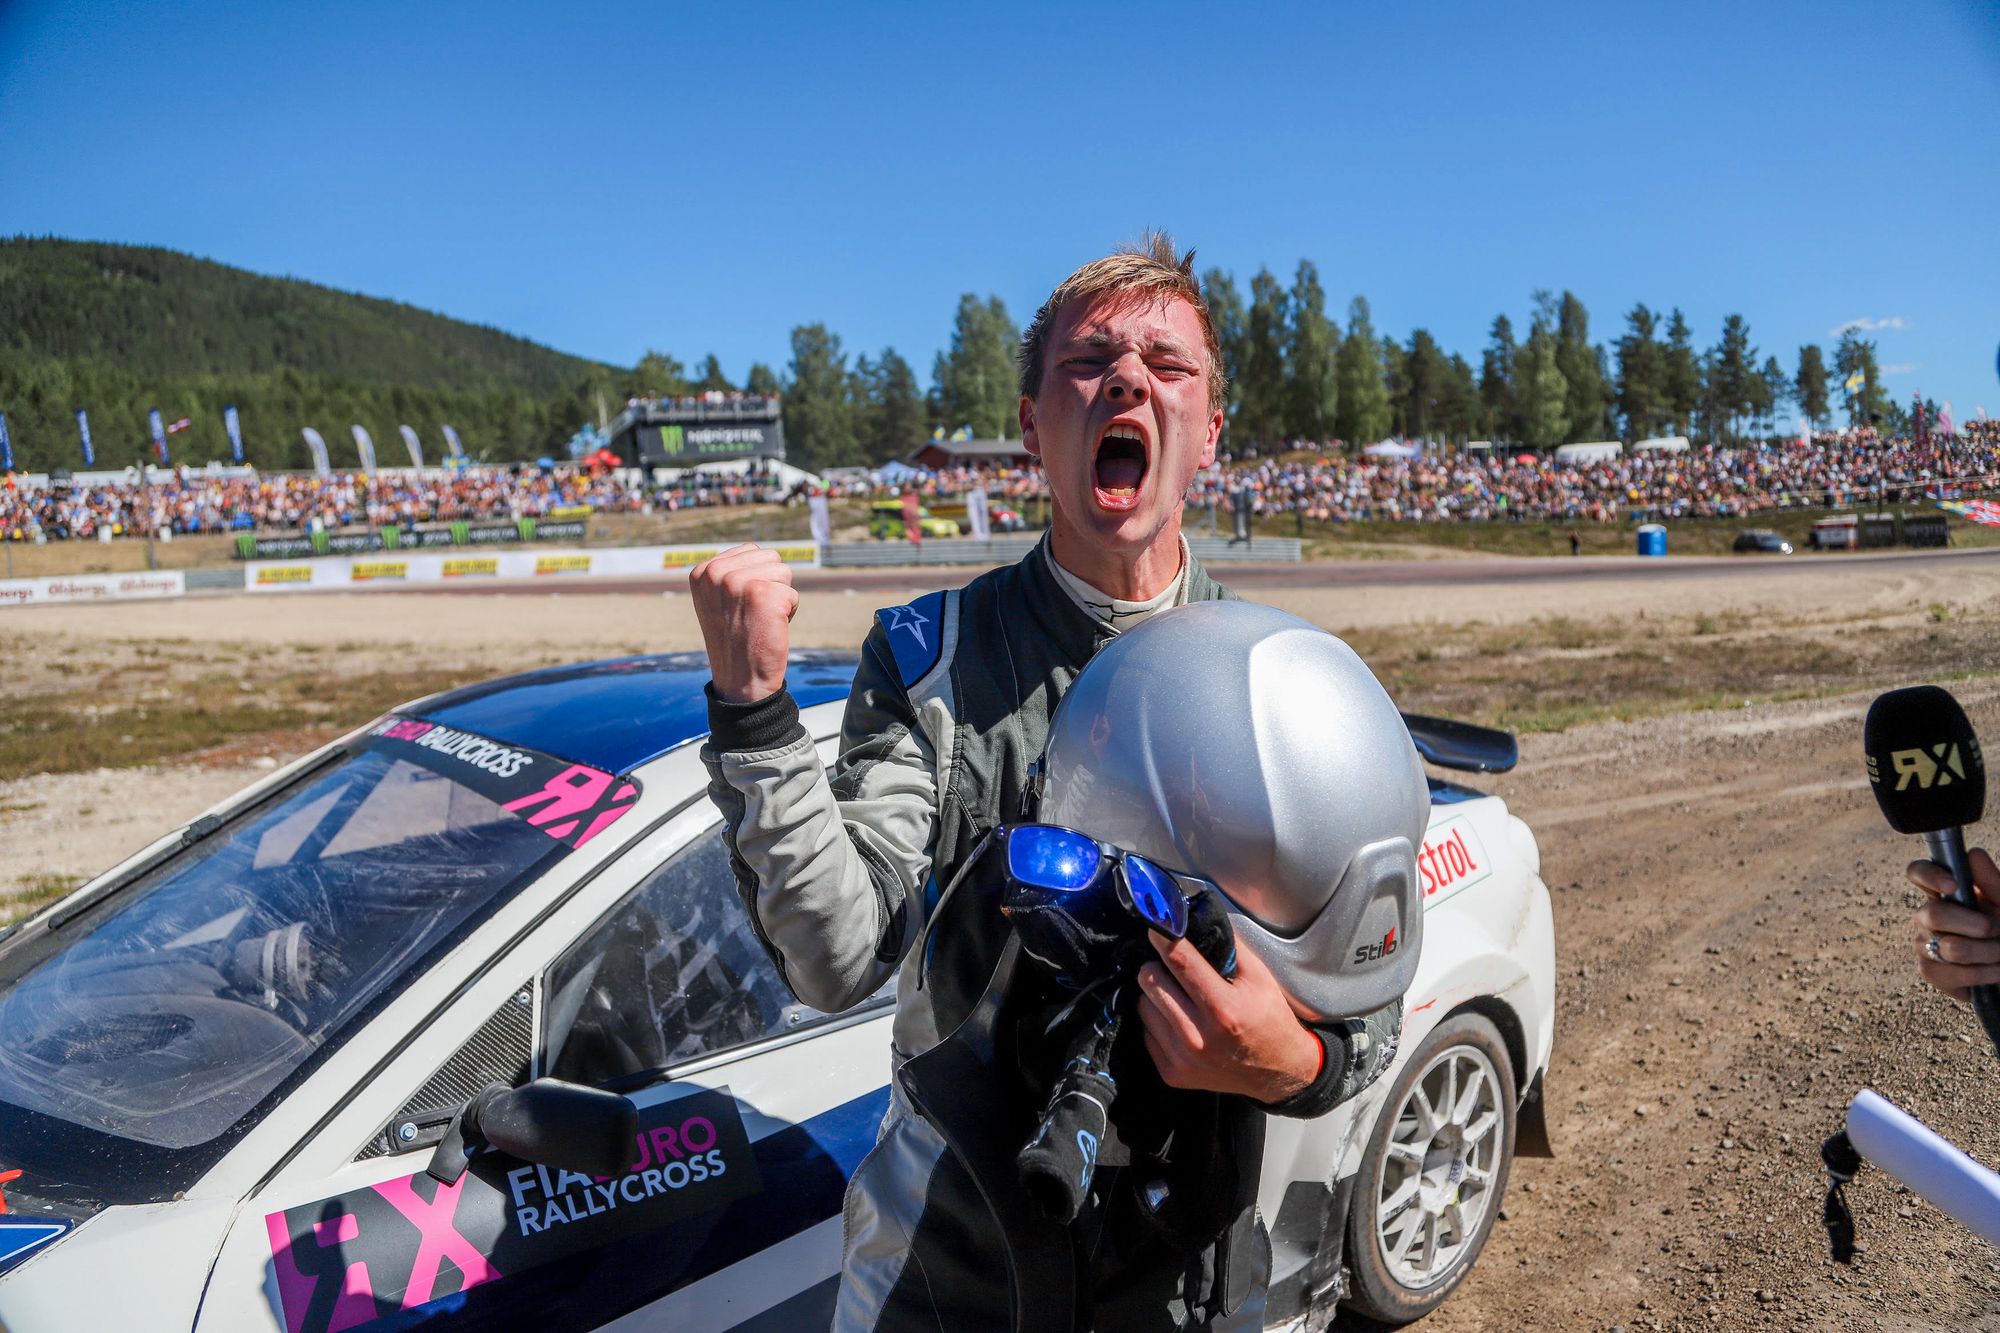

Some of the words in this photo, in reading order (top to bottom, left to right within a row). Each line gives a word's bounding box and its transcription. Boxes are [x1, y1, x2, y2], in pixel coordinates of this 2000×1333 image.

[415, 725, 534, 778] RALLYCROSS
[1418, 828, 1477, 898] strol
[1354, 927, 1398, 965] Stilo
[516, 1149, 726, 1237] RALLYCROSS
